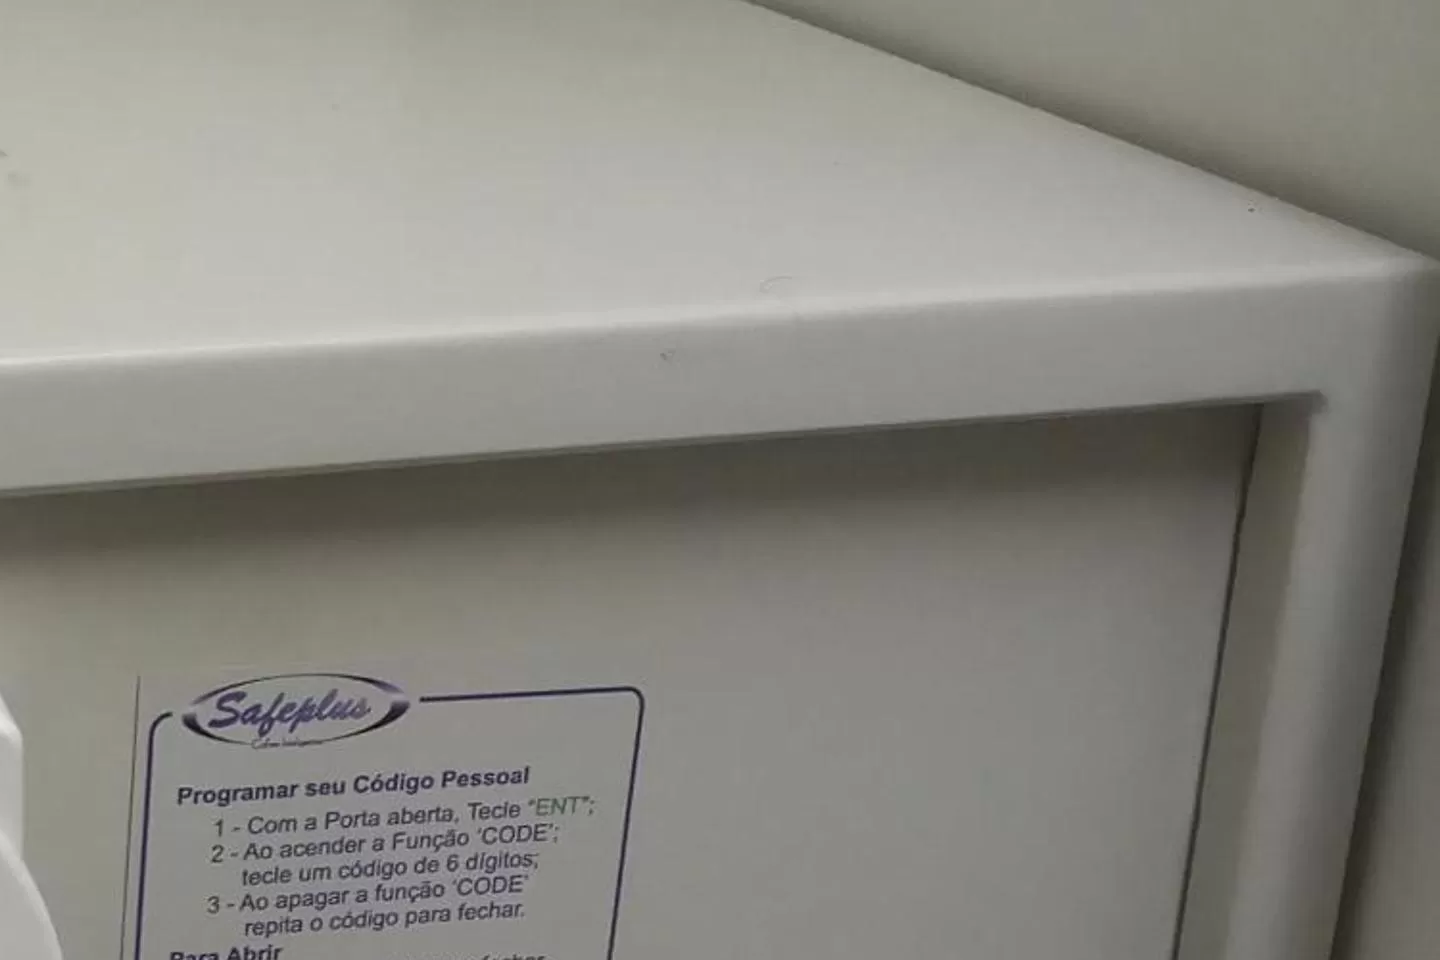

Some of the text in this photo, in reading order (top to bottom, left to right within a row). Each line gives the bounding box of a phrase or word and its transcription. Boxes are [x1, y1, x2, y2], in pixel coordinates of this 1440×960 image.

[207, 688, 371, 737] Safeplus
[177, 766, 530, 807] Programar seu Código Pessoal
[214, 819, 223, 837] 1
[248, 815, 297, 834] Com
[304, 816, 317, 830] a
[325, 810, 380, 829] Porta
[468, 802, 521, 820] Tecle
[211, 844, 224, 863] 2
[243, 842, 273, 860] Ao
[280, 837, 366, 858] acender
[372, 838, 384, 851] a
[393, 829, 469, 852] Função
[242, 868, 292, 886] tecle
[299, 867, 331, 881] um
[338, 859, 407, 882] código
[414, 857, 440, 874] de
[447, 854, 459, 872] 6
[207, 895, 220, 914] 3
[239, 893, 269, 912] Ao
[275, 889, 349, 911] apagar
[355, 889, 367, 903] a
[375, 880, 445, 902] função
[244, 901, 525, 938] repita o código para fechar.
